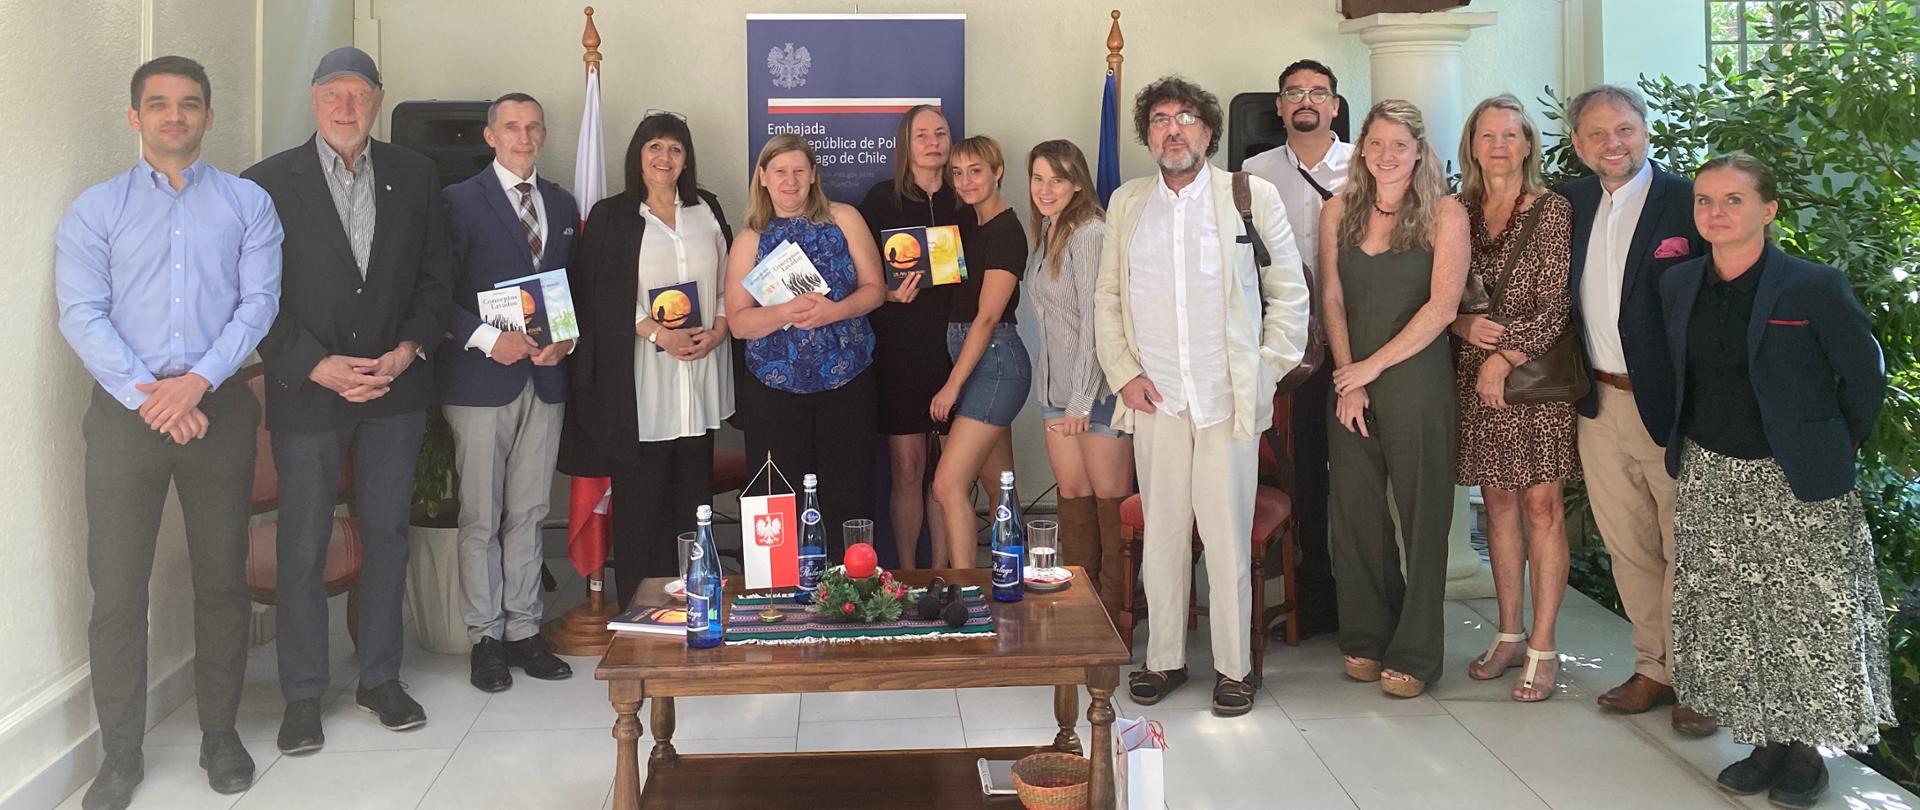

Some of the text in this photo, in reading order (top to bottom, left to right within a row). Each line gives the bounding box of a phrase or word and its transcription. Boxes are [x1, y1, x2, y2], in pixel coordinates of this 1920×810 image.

[768, 122, 826, 137] Embajada
[807, 136, 897, 151] epública de Pol
[815, 151, 887, 167] ago de Chile
